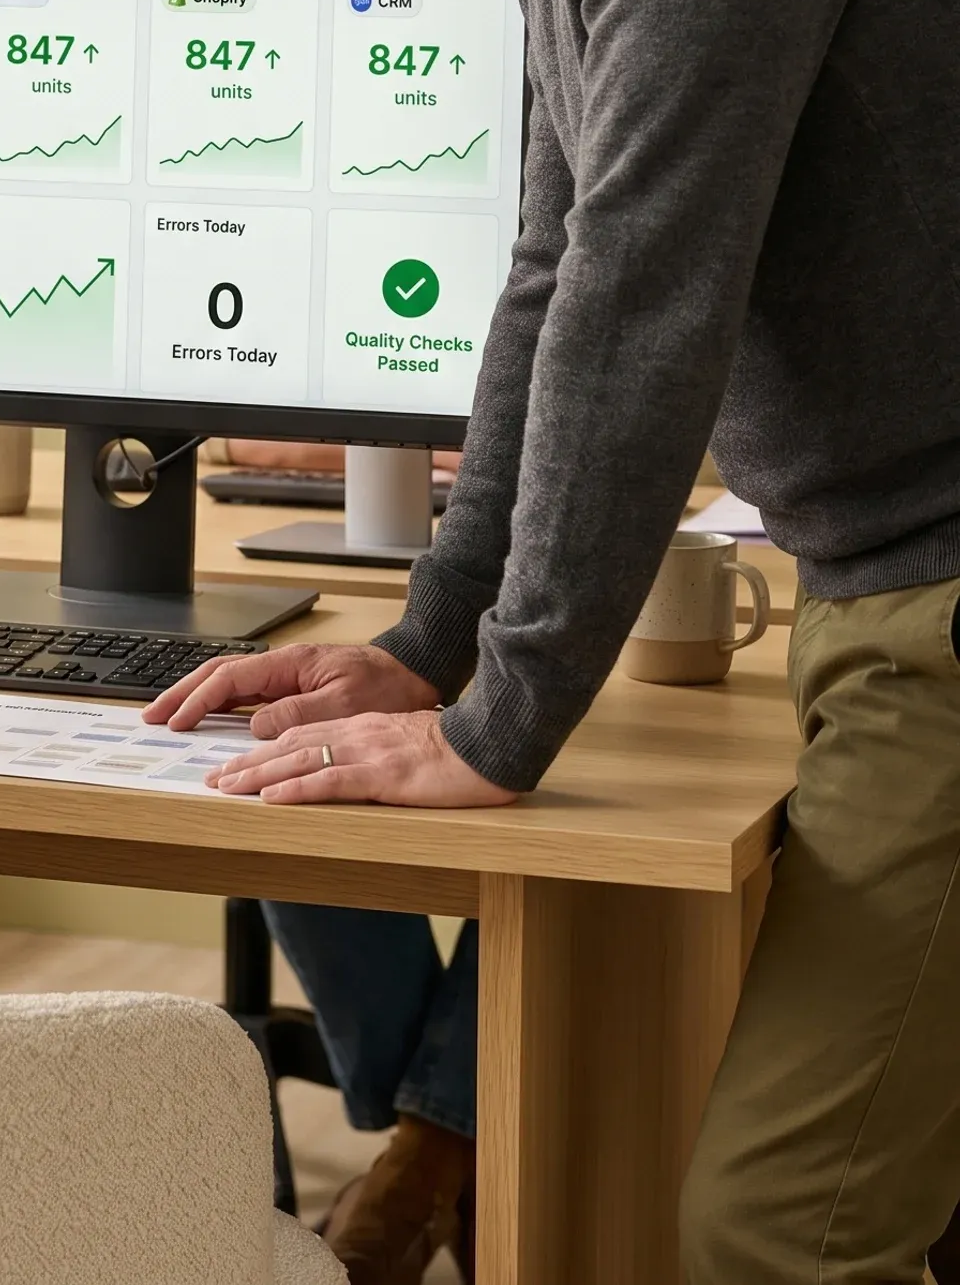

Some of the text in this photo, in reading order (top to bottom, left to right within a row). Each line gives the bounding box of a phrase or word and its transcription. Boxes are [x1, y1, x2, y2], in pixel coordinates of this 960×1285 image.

[6, 33, 76, 66] 847
[185, 39, 257, 72] 847
[368, 43, 441, 77] 847
[31, 77, 72, 95] units
[210, 83, 253, 100] units
[394, 89, 438, 107] units
[157, 217, 247, 237] Errors Today
[207, 281, 244, 330] 0
[345, 331, 474, 353] Quality Checks
[171, 343, 279, 367] Errors Today
[377, 355, 440, 374] Passed
